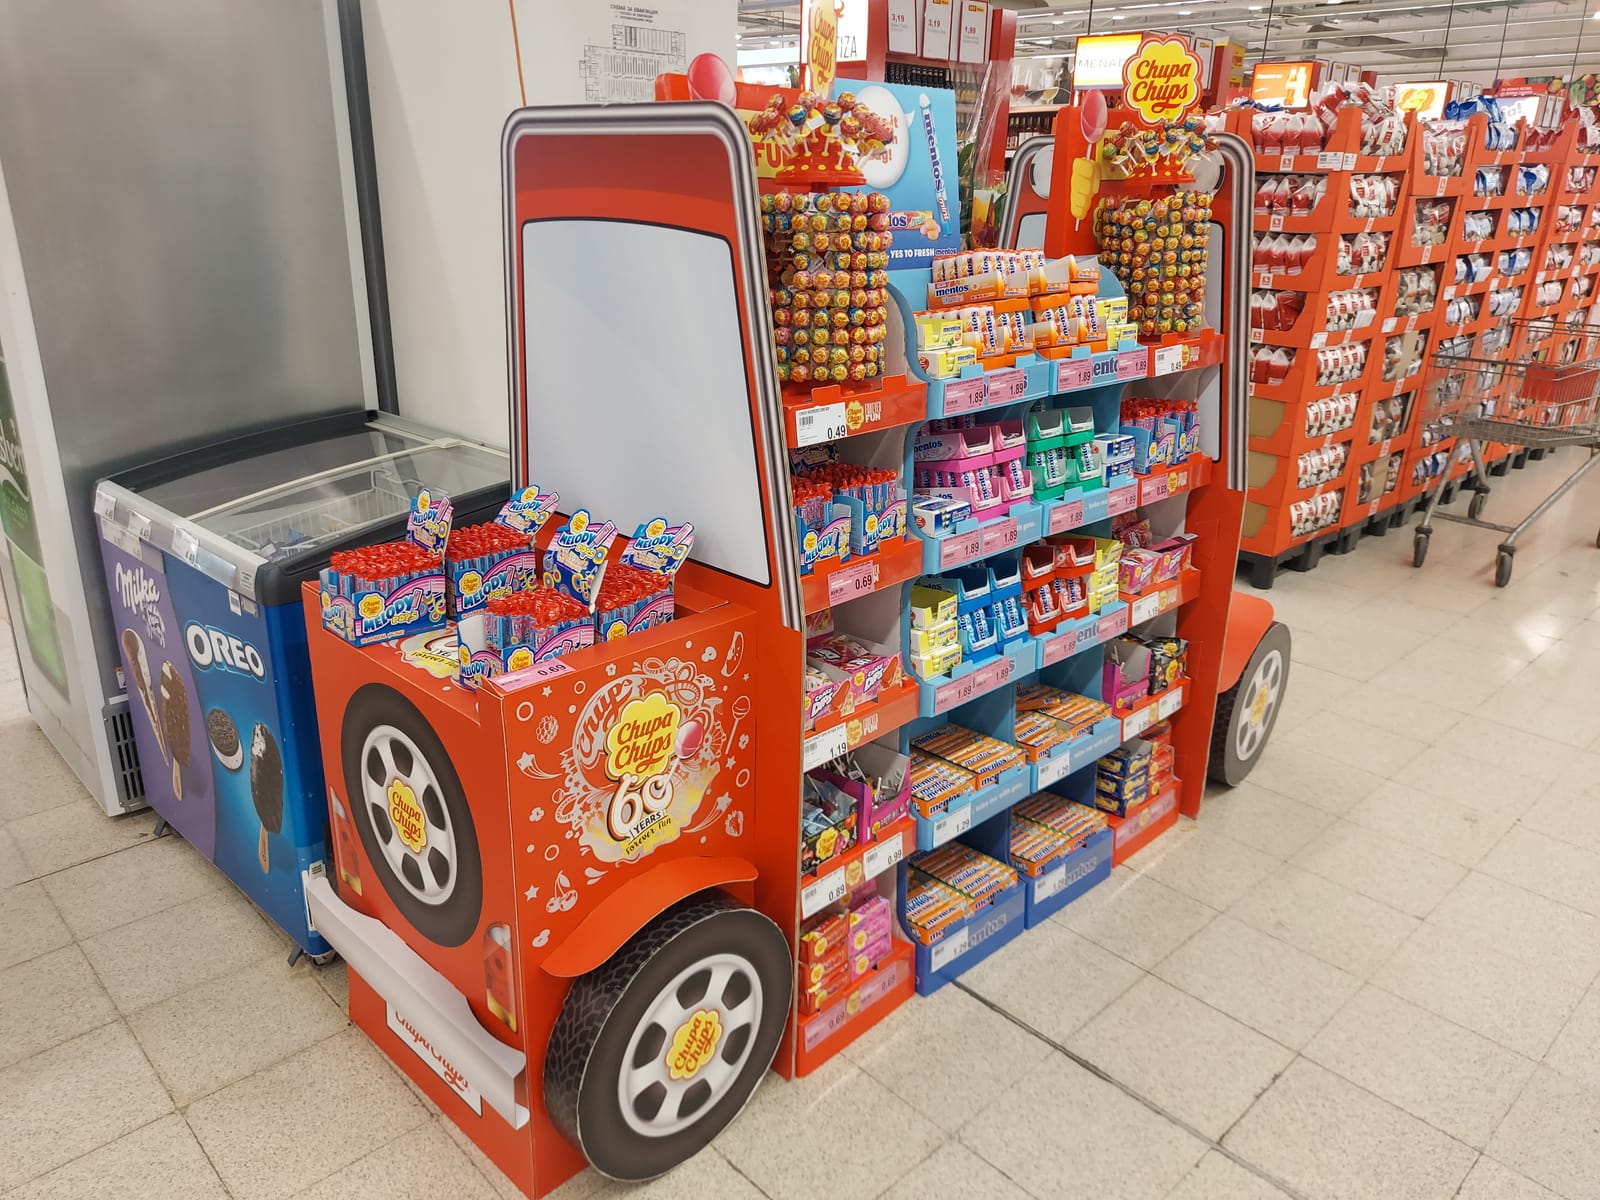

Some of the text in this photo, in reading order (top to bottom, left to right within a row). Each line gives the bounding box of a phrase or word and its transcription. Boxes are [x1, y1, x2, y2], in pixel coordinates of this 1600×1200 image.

[814, 7, 836, 45] Chupa
[811, 36, 834, 85] Chups
[1135, 59, 1192, 84] Chupa
[1132, 80, 1189, 114] Chups
[754, 142, 788, 169] FU
[924, 112, 943, 193] mentos
[889, 214, 908, 228] tos
[890, 250, 904, 259] YES
[904, 249, 915, 258] TO
[914, 248, 935, 258] FRESH
[935, 284, 969, 297] mentos
[1135, 360, 1147, 371] 1.89
[1078, 370, 1091, 383] 1.89
[1010, 383, 1024, 396] 1.89
[968, 391, 984, 405] 1.89
[865, 412, 881, 423] FUN
[827, 424, 846, 439] 0.49
[509, 501, 542, 512] MELODY
[413, 509, 438, 524] MELODY
[867, 516, 893, 545] MELODY
[1004, 529, 1018, 543] 1.89
[558, 532, 597, 547] MELODY
[634, 535, 675, 549] MELODY
[804, 531, 834, 563] MELODY
[965, 541, 980, 556] 1.89
[115, 561, 160, 615] Milka
[855, 574, 872, 590] 0.69
[462, 571, 508, 610] MELODY
[362, 595, 415, 633] MELODY
[391, 611, 418, 625] POPS
[186, 624, 265, 678] OREO
[461, 661, 485, 677] MELODY
[537, 664, 567, 677] 0.69
[996, 667, 1009, 681] 1.89
[958, 684, 972, 699] 1.89
[617, 711, 673, 746] Chupa
[614, 732, 671, 774] Chups
[830, 742, 847, 758] 1.19
[392, 791, 421, 822] Chupa
[607, 773, 674, 842] 60
[392, 806, 421, 843] Chups
[633, 811, 662, 834] YEARS
[957, 818, 970, 833] 1.29
[887, 848, 902, 865] 0.99
[828, 883, 845, 902] 0.89
[828, 1012, 845, 1029] 0.69
[674, 1017, 702, 1070] Chupa
[685, 1020, 716, 1073] Chups
